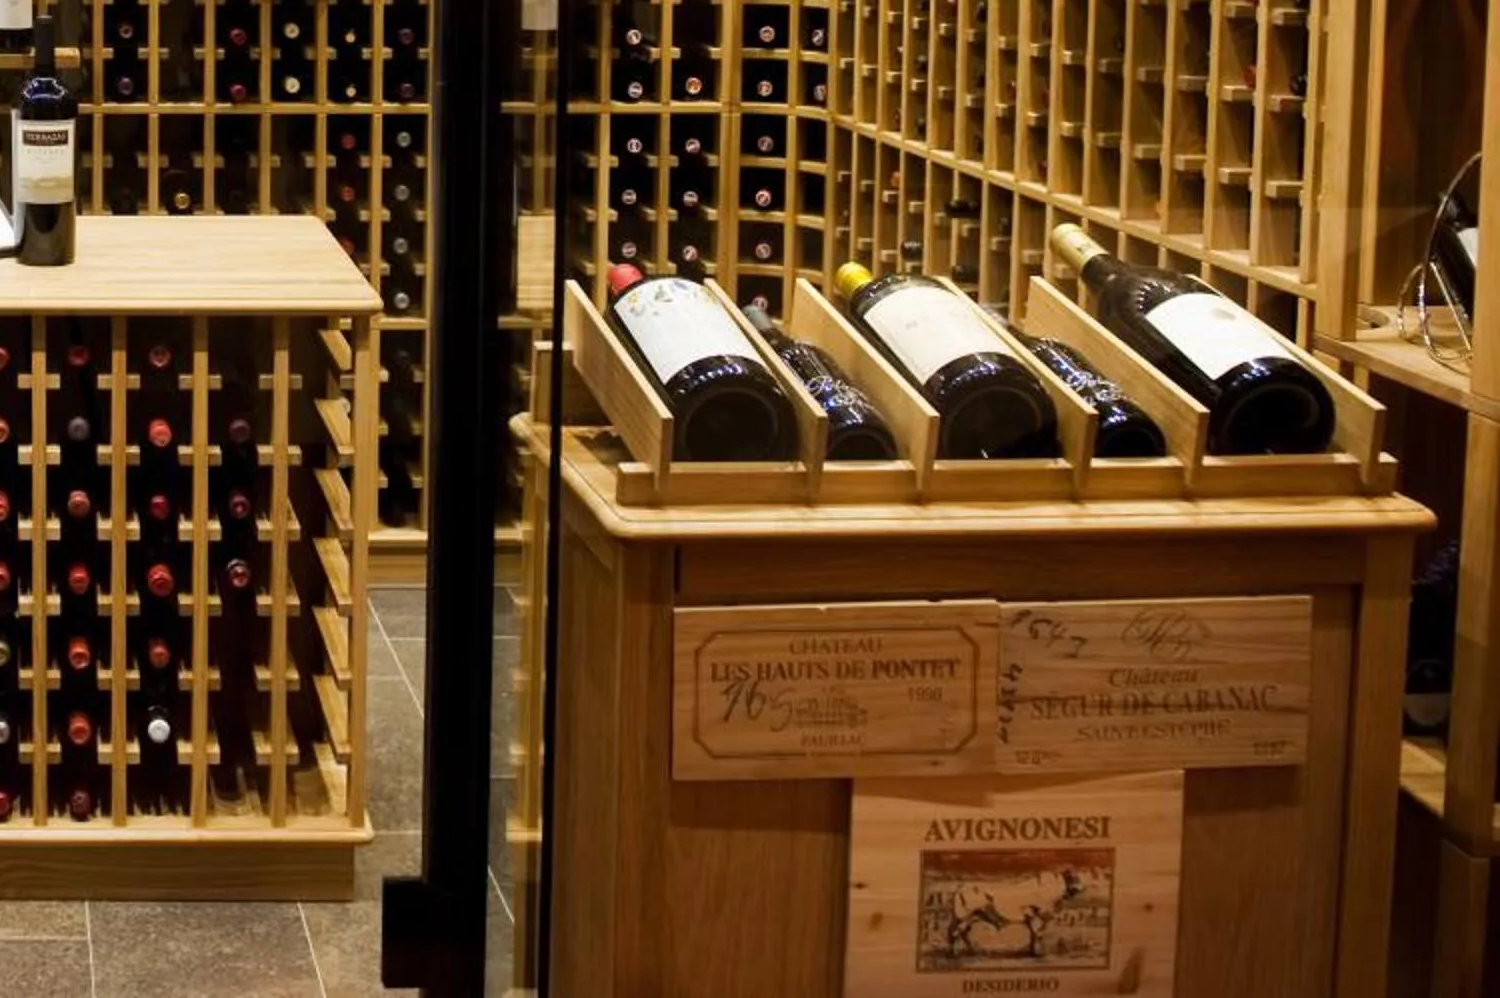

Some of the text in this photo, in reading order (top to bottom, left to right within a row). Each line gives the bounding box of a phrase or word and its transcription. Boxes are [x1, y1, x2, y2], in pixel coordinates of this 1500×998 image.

[711, 658, 961, 682] LES HAUTS DE PONTET
[1122, 692, 1158, 715] DE
[924, 816, 1111, 842] AVIGNONESI
[962, 978, 1060, 994] DESIDERIO
